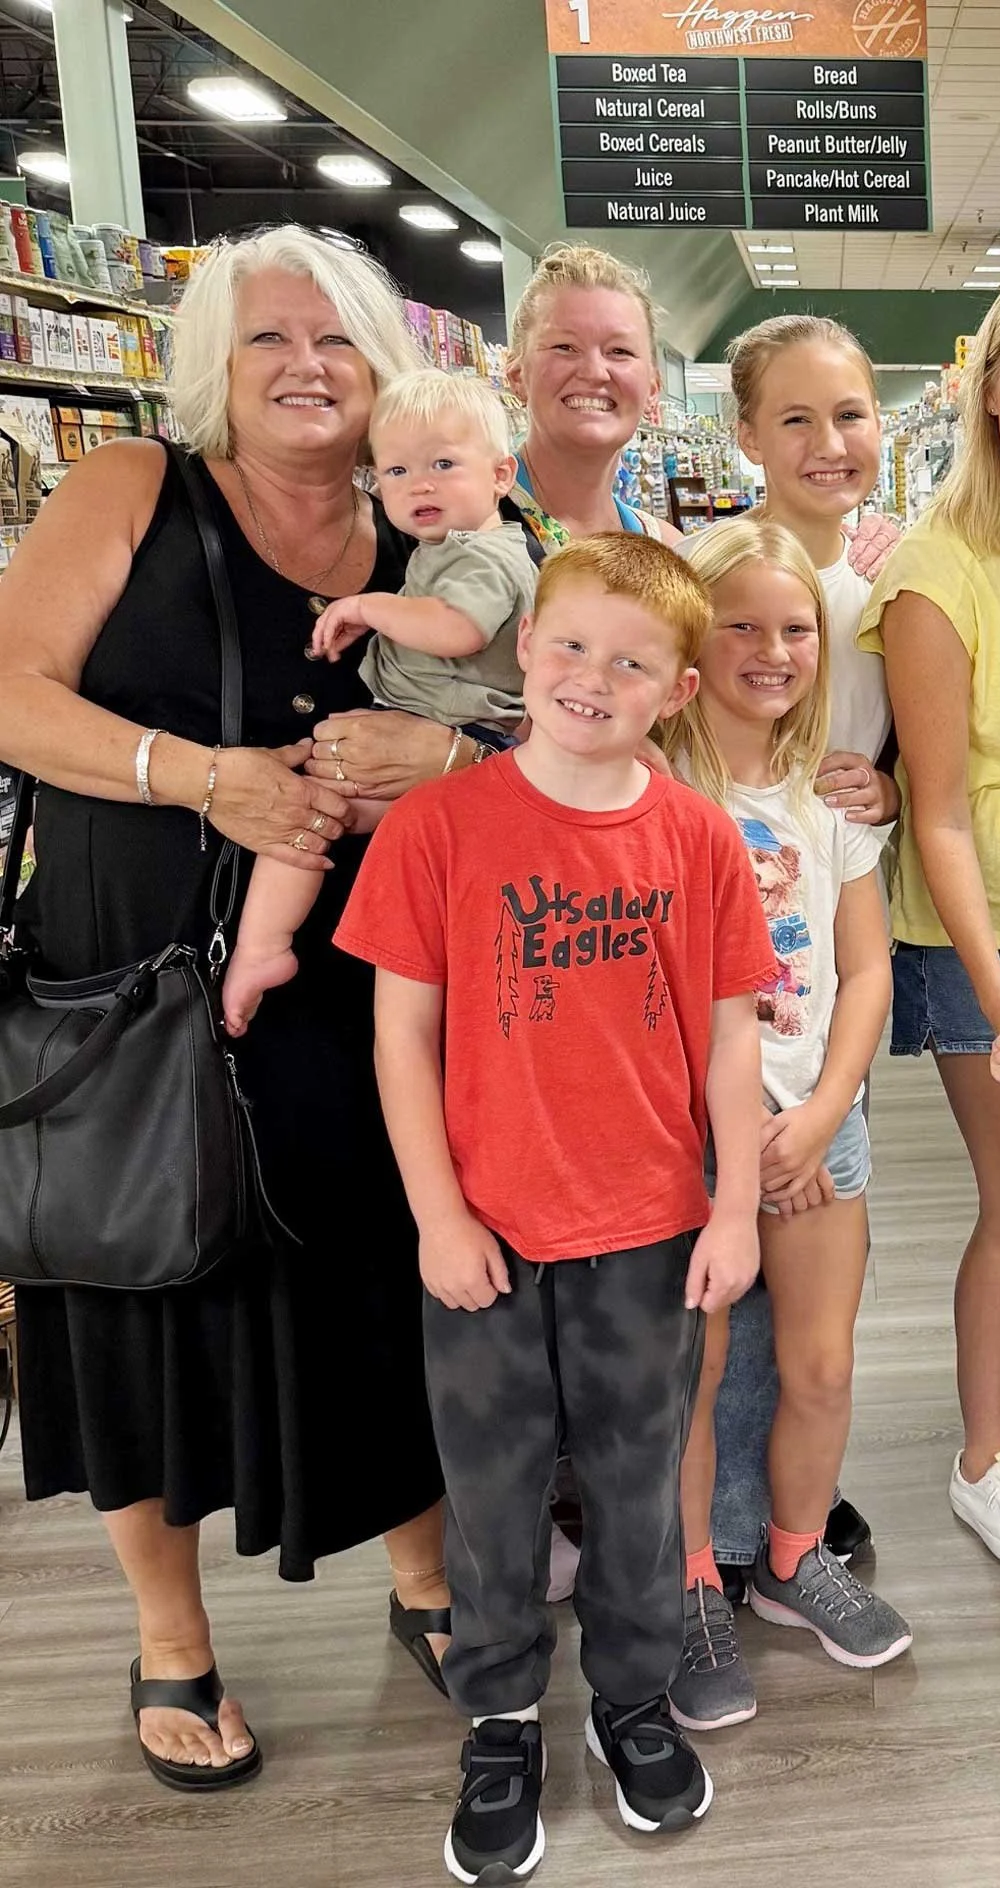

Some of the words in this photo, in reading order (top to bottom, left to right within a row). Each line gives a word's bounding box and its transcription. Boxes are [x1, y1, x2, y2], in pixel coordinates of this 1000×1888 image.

[568, 0, 591, 44] 1
[661, 0, 814, 30] Haggen
[688, 26, 753, 49] NORTHWEST
[755, 23, 791, 42] FRESH
[611, 63, 656, 83] Boxed
[660, 64, 687, 83] Tea
[813, 66, 858, 85] Bread
[595, 98, 652, 118] Natural
[656, 99, 706, 118] Cereal
[796, 101, 877, 120] Rolls/Buns
[600, 133, 644, 152] Boxed
[649, 134, 706, 152] Cereals
[768, 135, 821, 154] Peanut
[825, 135, 907, 157] Butter/Jelly
[634, 168, 673, 187] Juice
[766, 169, 859, 189] Pancake/Hot
[864, 170, 910, 189] Cereal
[607, 202, 664, 221] Natural
[667, 202, 706, 221] Juice
[804, 204, 845, 223] Plant
[848, 204, 879, 223] Milk
[522, 923, 648, 970] Eagles
